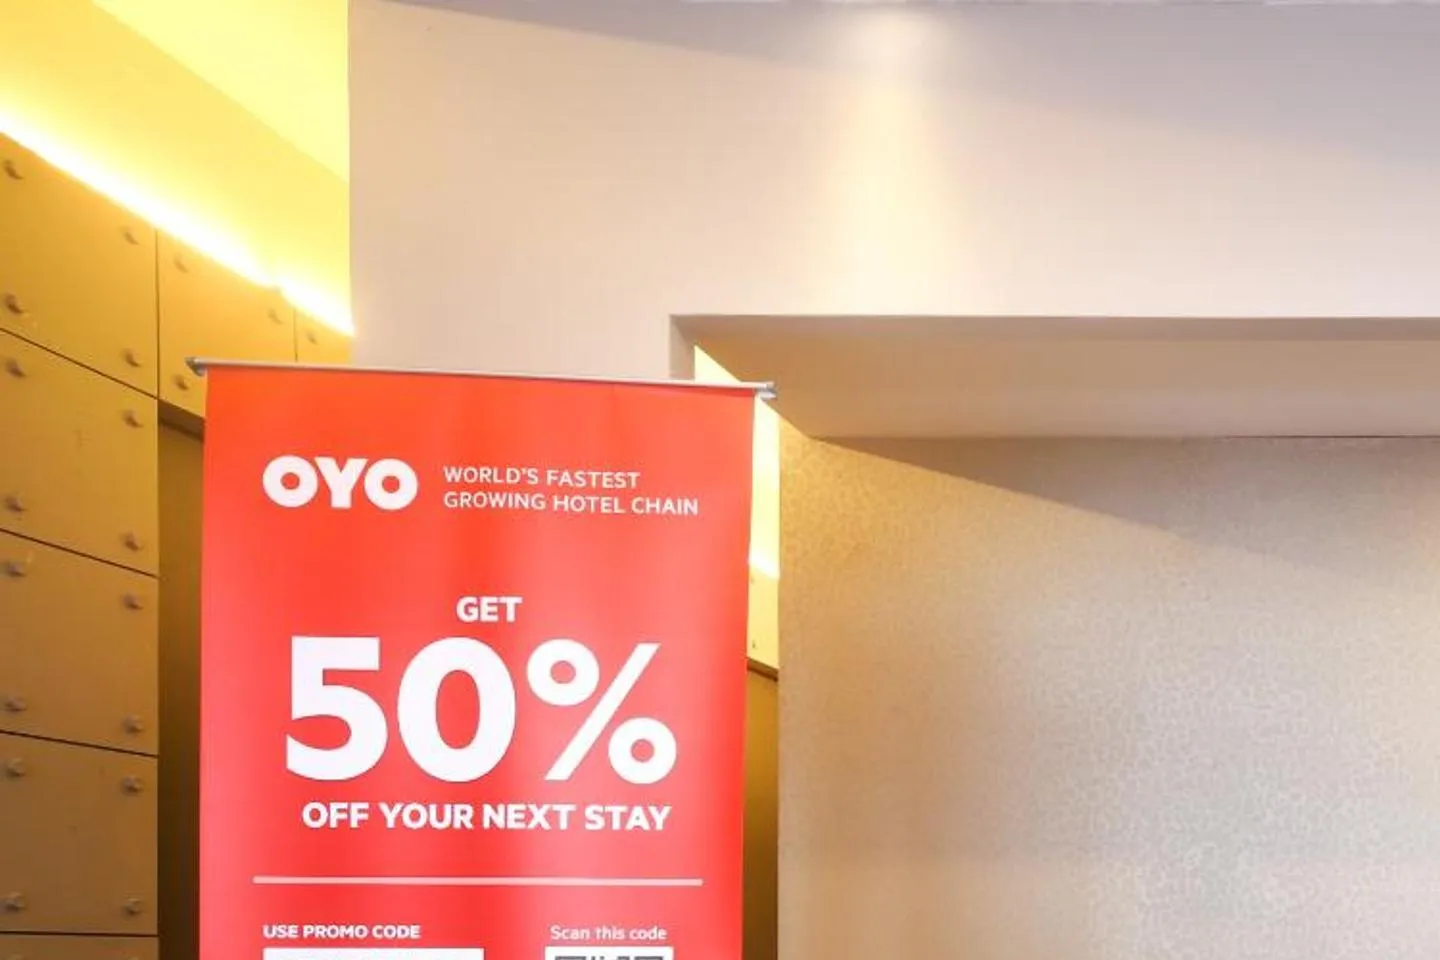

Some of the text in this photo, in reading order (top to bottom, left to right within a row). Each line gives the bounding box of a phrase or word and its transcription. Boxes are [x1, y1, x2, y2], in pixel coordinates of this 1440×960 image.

[262, 454, 419, 511] OYO
[443, 466, 641, 489] WORLD'S FASTEST
[443, 492, 699, 516] GROWING HOTEL CHAIN
[456, 596, 523, 623] GET
[285, 635, 678, 785] 50%
[302, 802, 672, 831] OFF YOUR NEXT STAY
[263, 925, 421, 940] USE PROMO CODE
[550, 924, 668, 941] Scan this code
